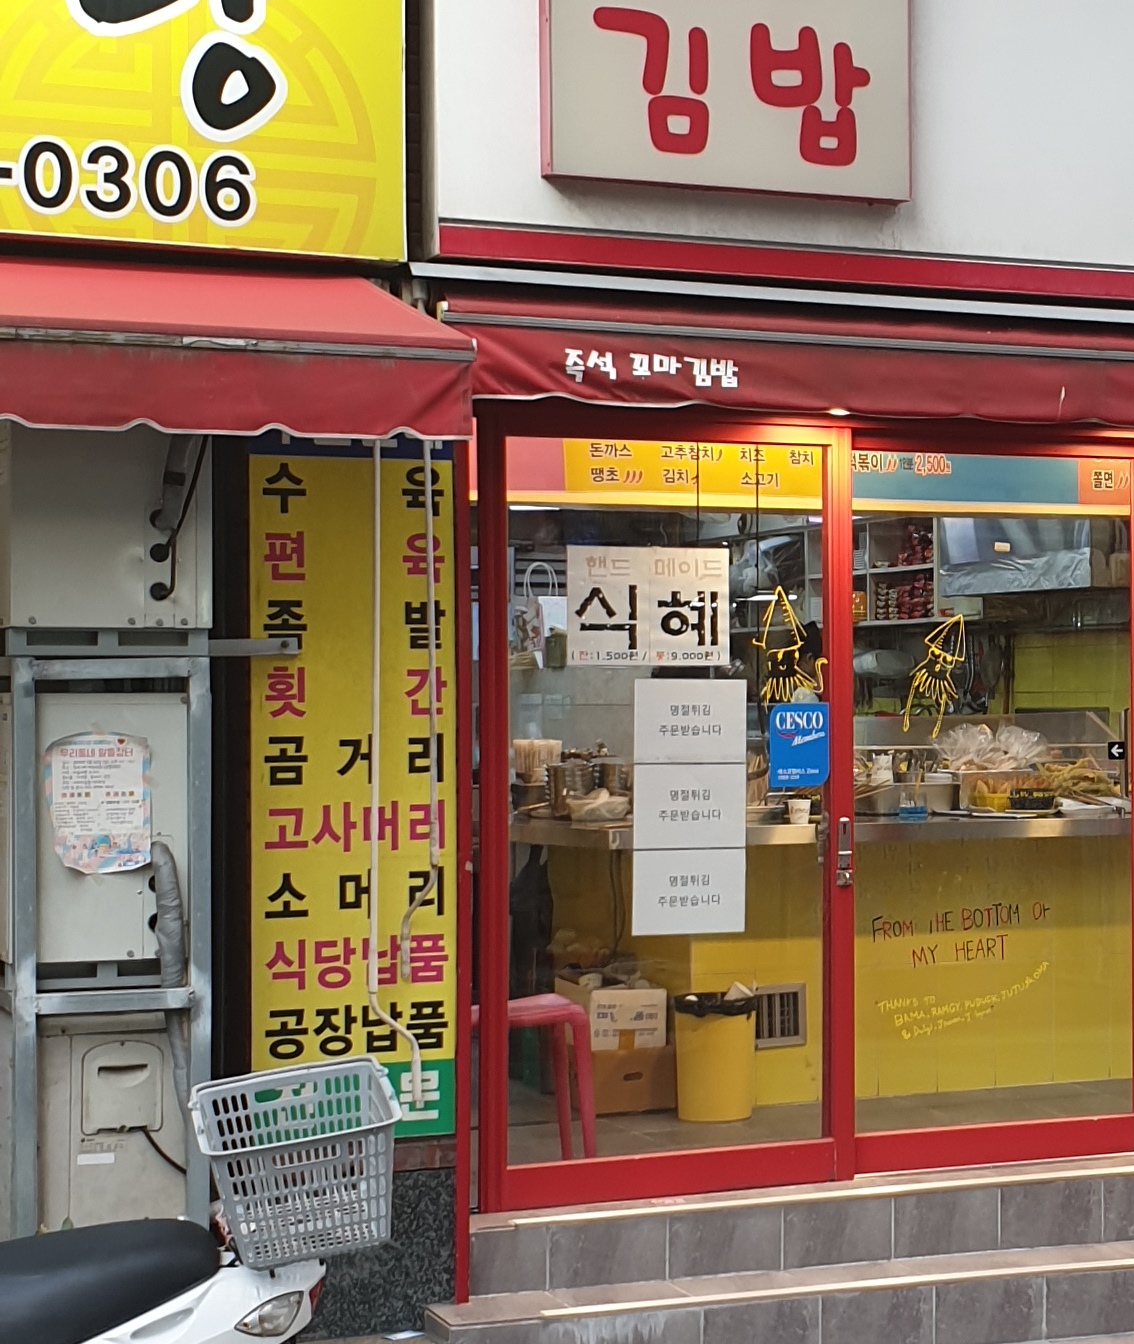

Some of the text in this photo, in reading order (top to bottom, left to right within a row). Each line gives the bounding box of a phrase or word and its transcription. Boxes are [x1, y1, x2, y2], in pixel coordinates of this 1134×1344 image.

[593, 6, 871, 167] 김밥
[565, 347, 617, 383] 즉석
[589, 442, 815, 466] 돈까스 고추참치 치즈 참치
[590, 467, 779, 488] 땡초 김치 소고기
[1092, 470, 1114, 490] 쫄면
[585, 555, 723, 580] 핸드 메이드
[574, 583, 719, 651] 식혜
[776, 711, 823, 730] CESCO
[264, 801, 447, 853] 고사머리
[872, 915, 914, 943] FROM
[961, 902, 1021, 932] BOTTOM
[264, 934, 448, 991] 식당납품
[912, 934, 1009, 968] MY HEART
[264, 1001, 449, 1059] 공장납품
